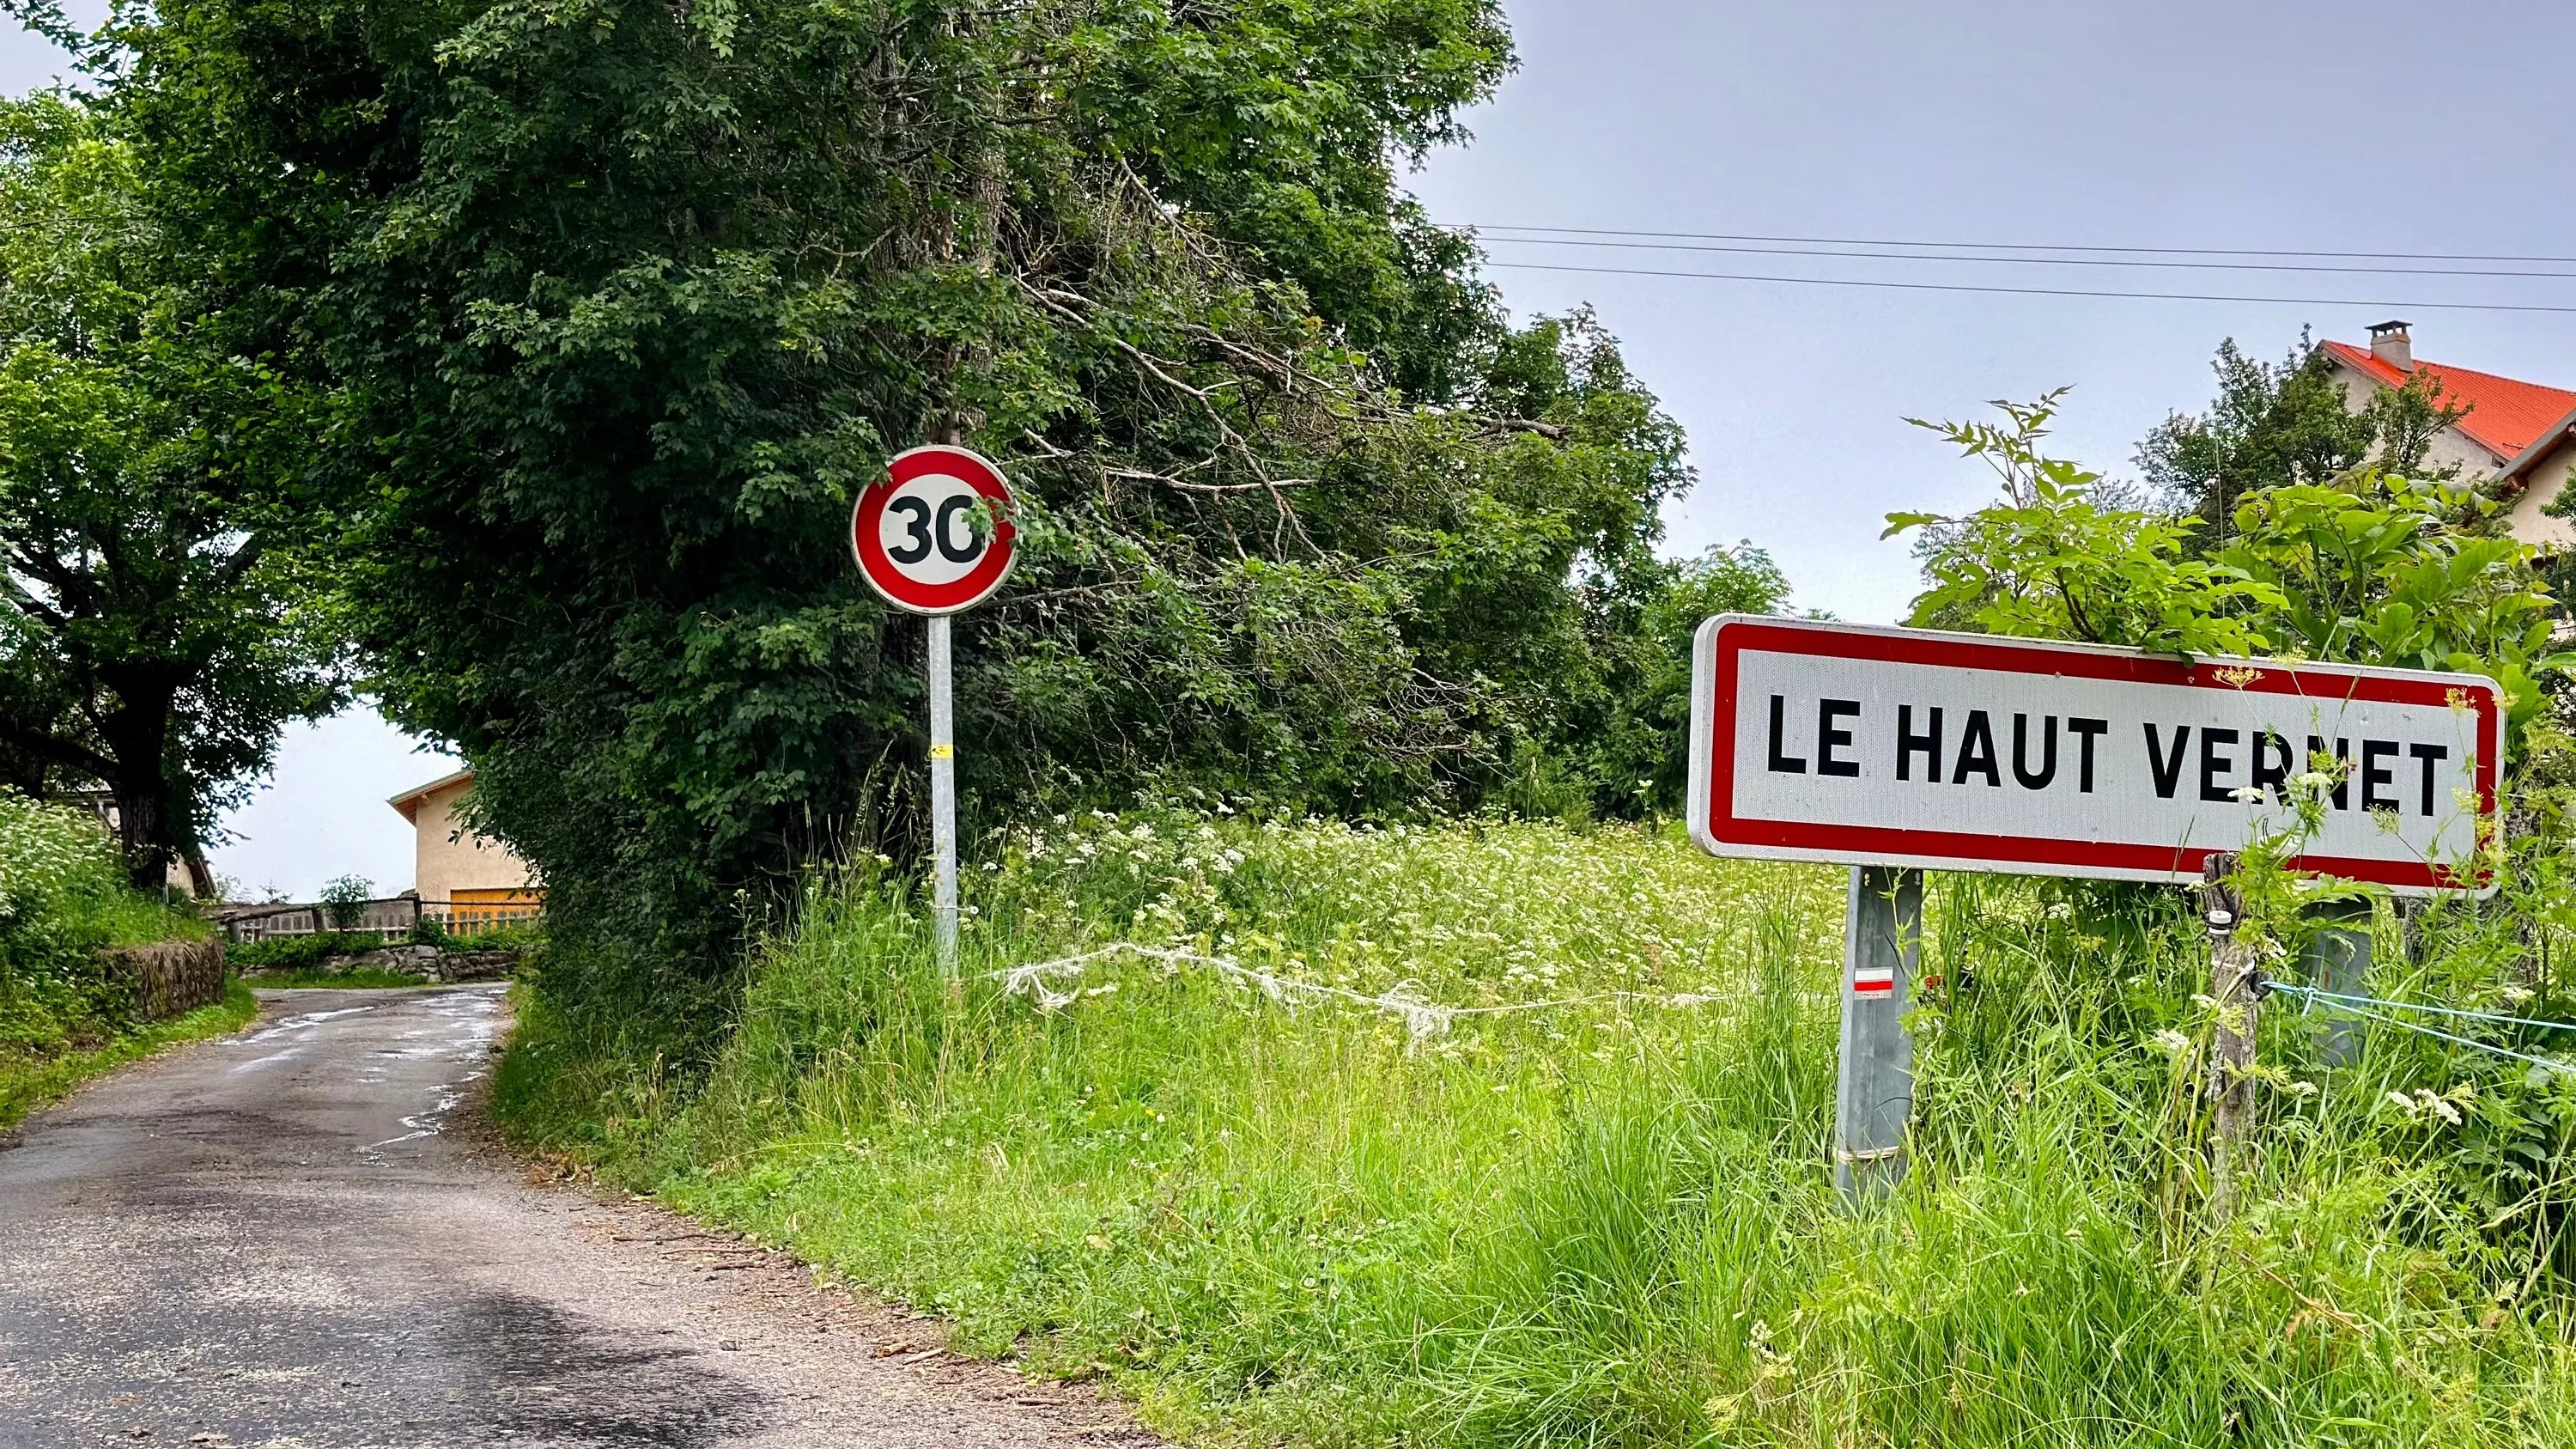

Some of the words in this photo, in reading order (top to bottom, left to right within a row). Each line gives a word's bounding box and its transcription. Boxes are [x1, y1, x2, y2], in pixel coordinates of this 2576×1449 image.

[888, 494, 986, 564] 30
[1767, 694, 1861, 778] LE
[1895, 704, 2109, 794] HAUT
[2142, 722, 2448, 817] VERNET
